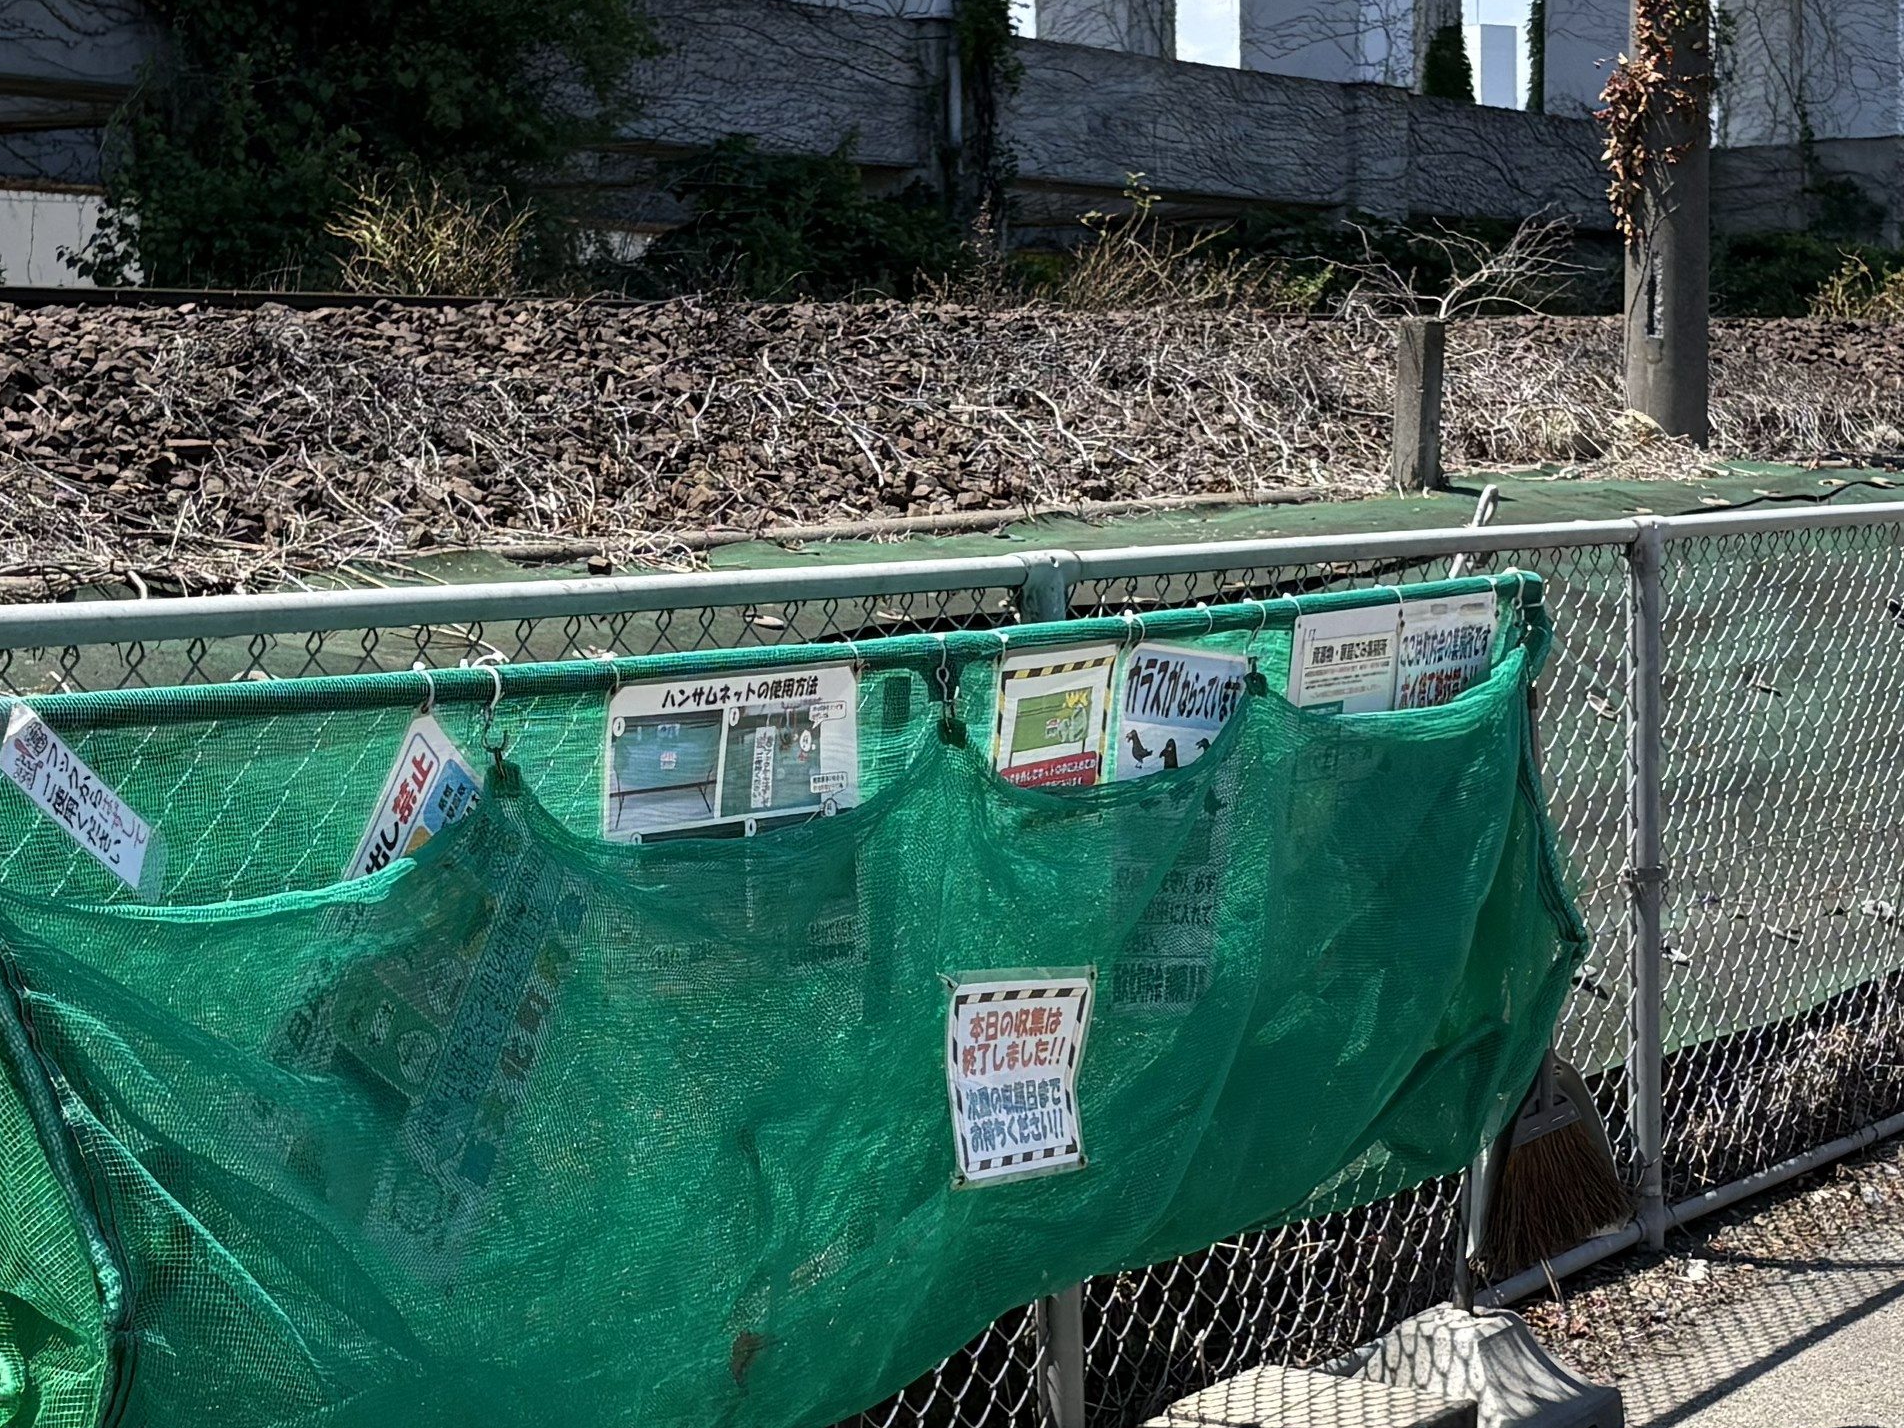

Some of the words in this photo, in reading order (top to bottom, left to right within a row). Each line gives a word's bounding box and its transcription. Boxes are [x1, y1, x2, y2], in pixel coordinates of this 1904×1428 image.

[662, 675, 819, 708] ハンサムネットの使用方法
[969, 1006, 1063, 1043] 本日の収集は
[962, 1036, 1066, 1077] 終了しました!!
